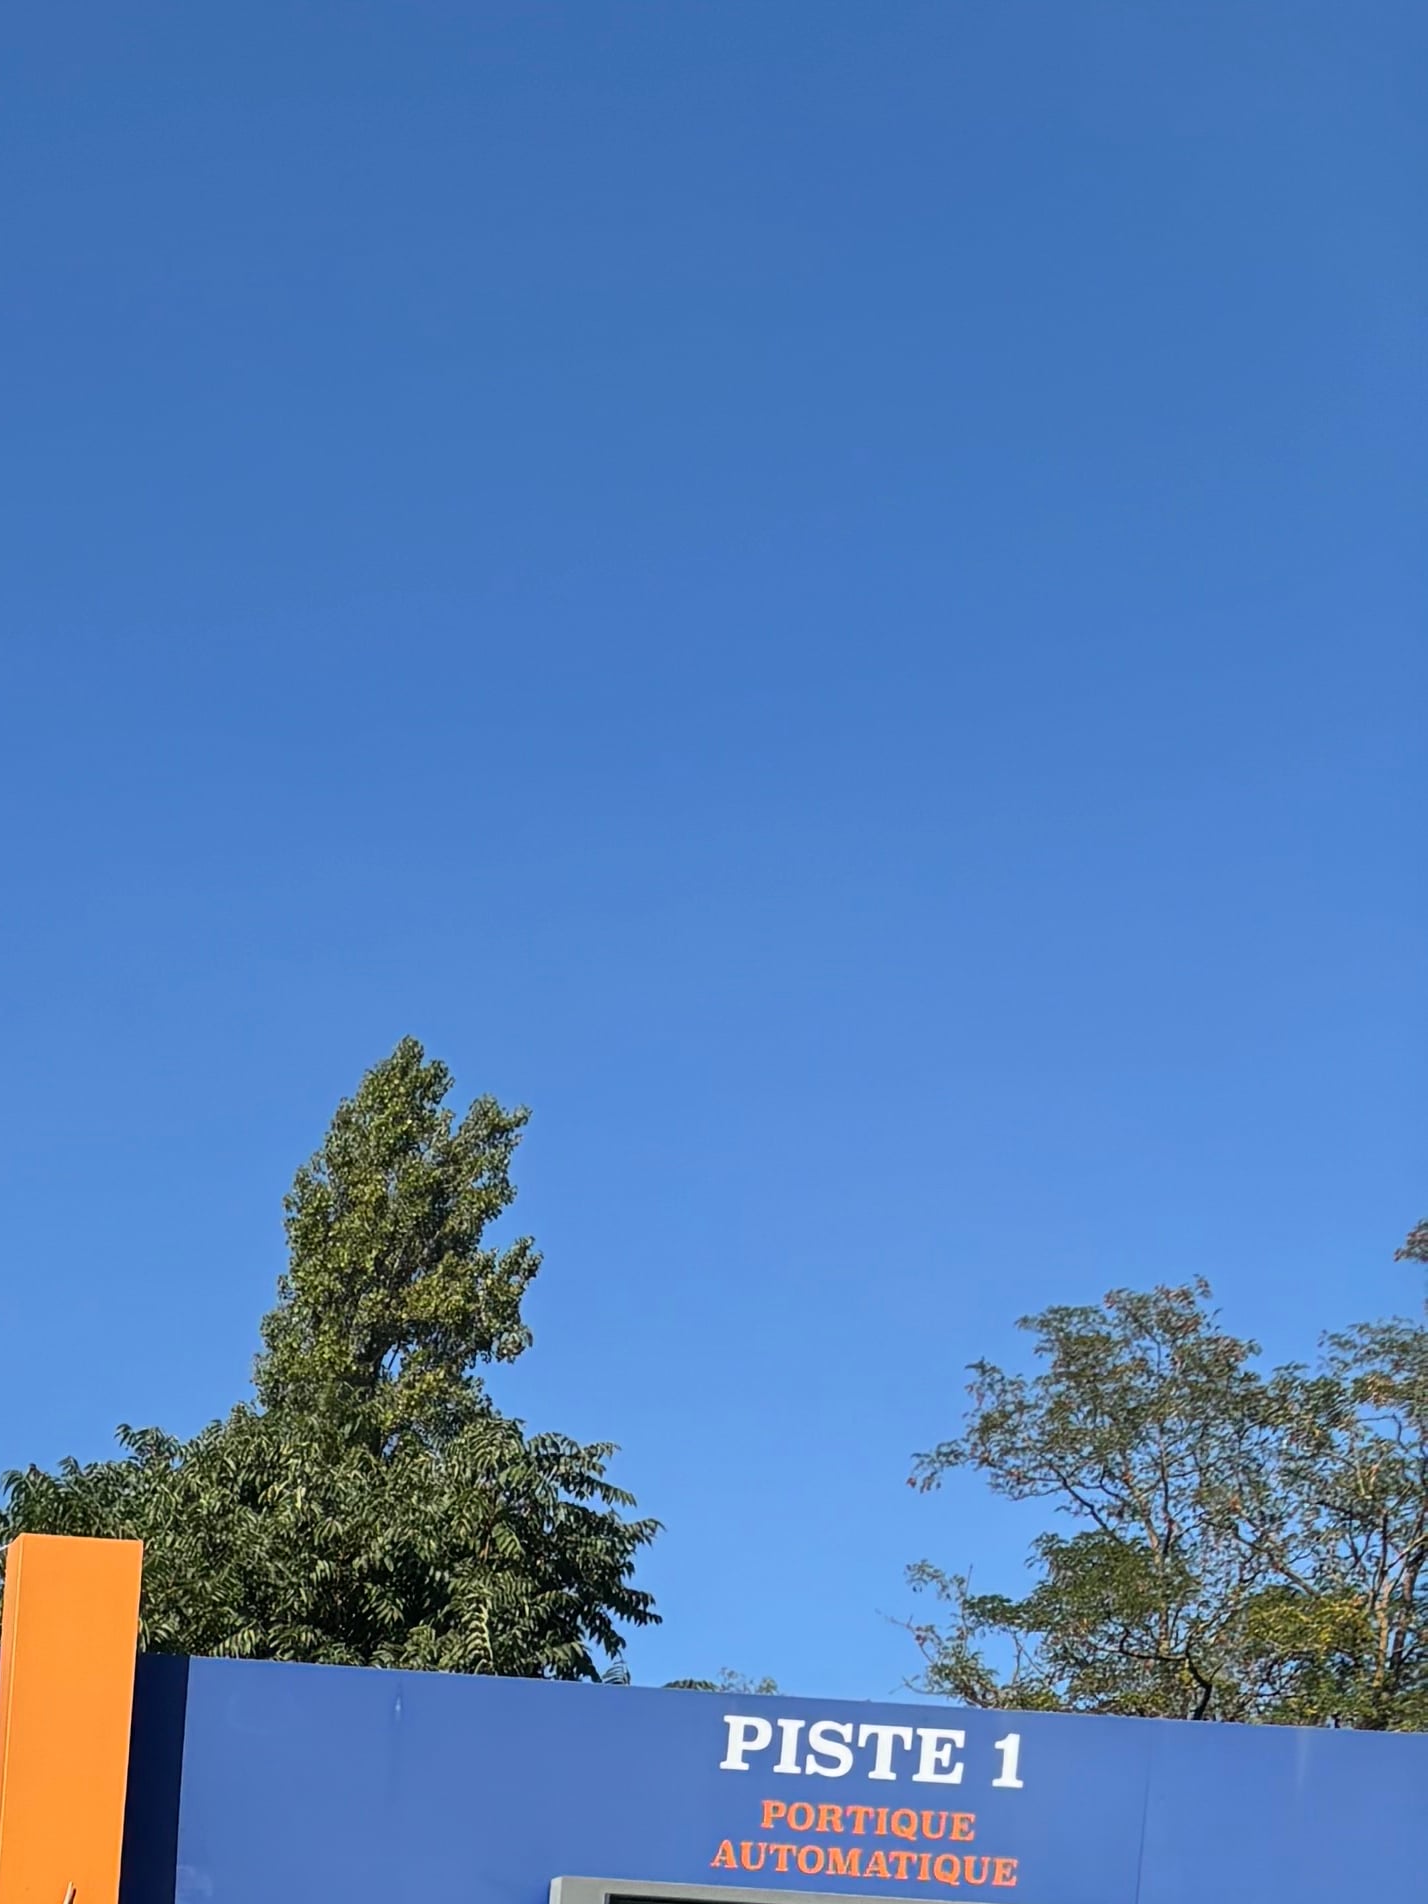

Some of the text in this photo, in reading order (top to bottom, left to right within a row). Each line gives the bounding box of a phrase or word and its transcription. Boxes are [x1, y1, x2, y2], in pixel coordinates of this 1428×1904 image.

[719, 1714, 1024, 1789] PISTE 1
[760, 1799, 977, 1842] PORTIQUE
[710, 1839, 1020, 1888] AUTOMATIQUE
